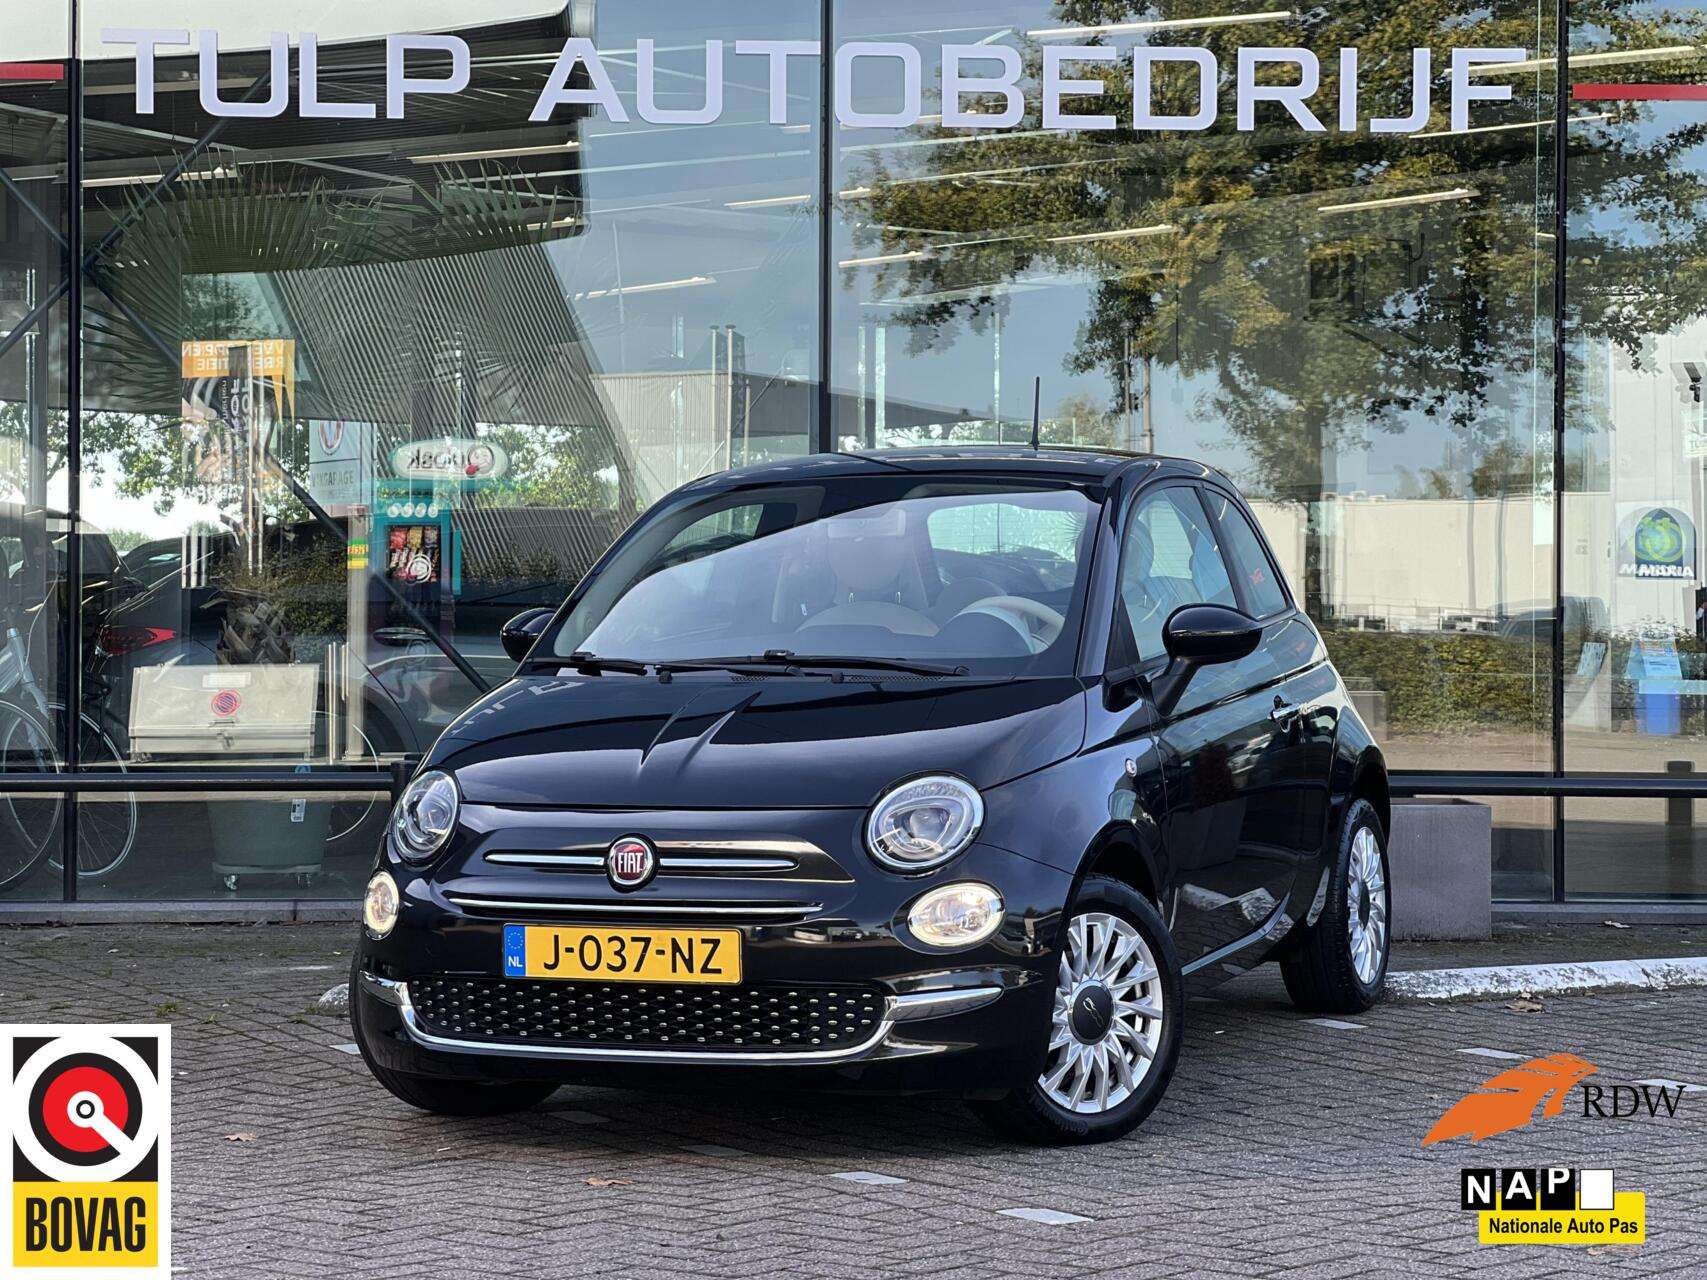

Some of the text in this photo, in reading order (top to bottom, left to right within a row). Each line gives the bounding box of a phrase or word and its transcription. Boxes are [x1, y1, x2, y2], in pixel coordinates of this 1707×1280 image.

[101, 28, 1526, 134] TULP AUTOBEDRIJF
[617, 852, 644, 873] FIAT
[508, 956, 523, 967] NL
[543, 934, 723, 974] J-037-NZ
